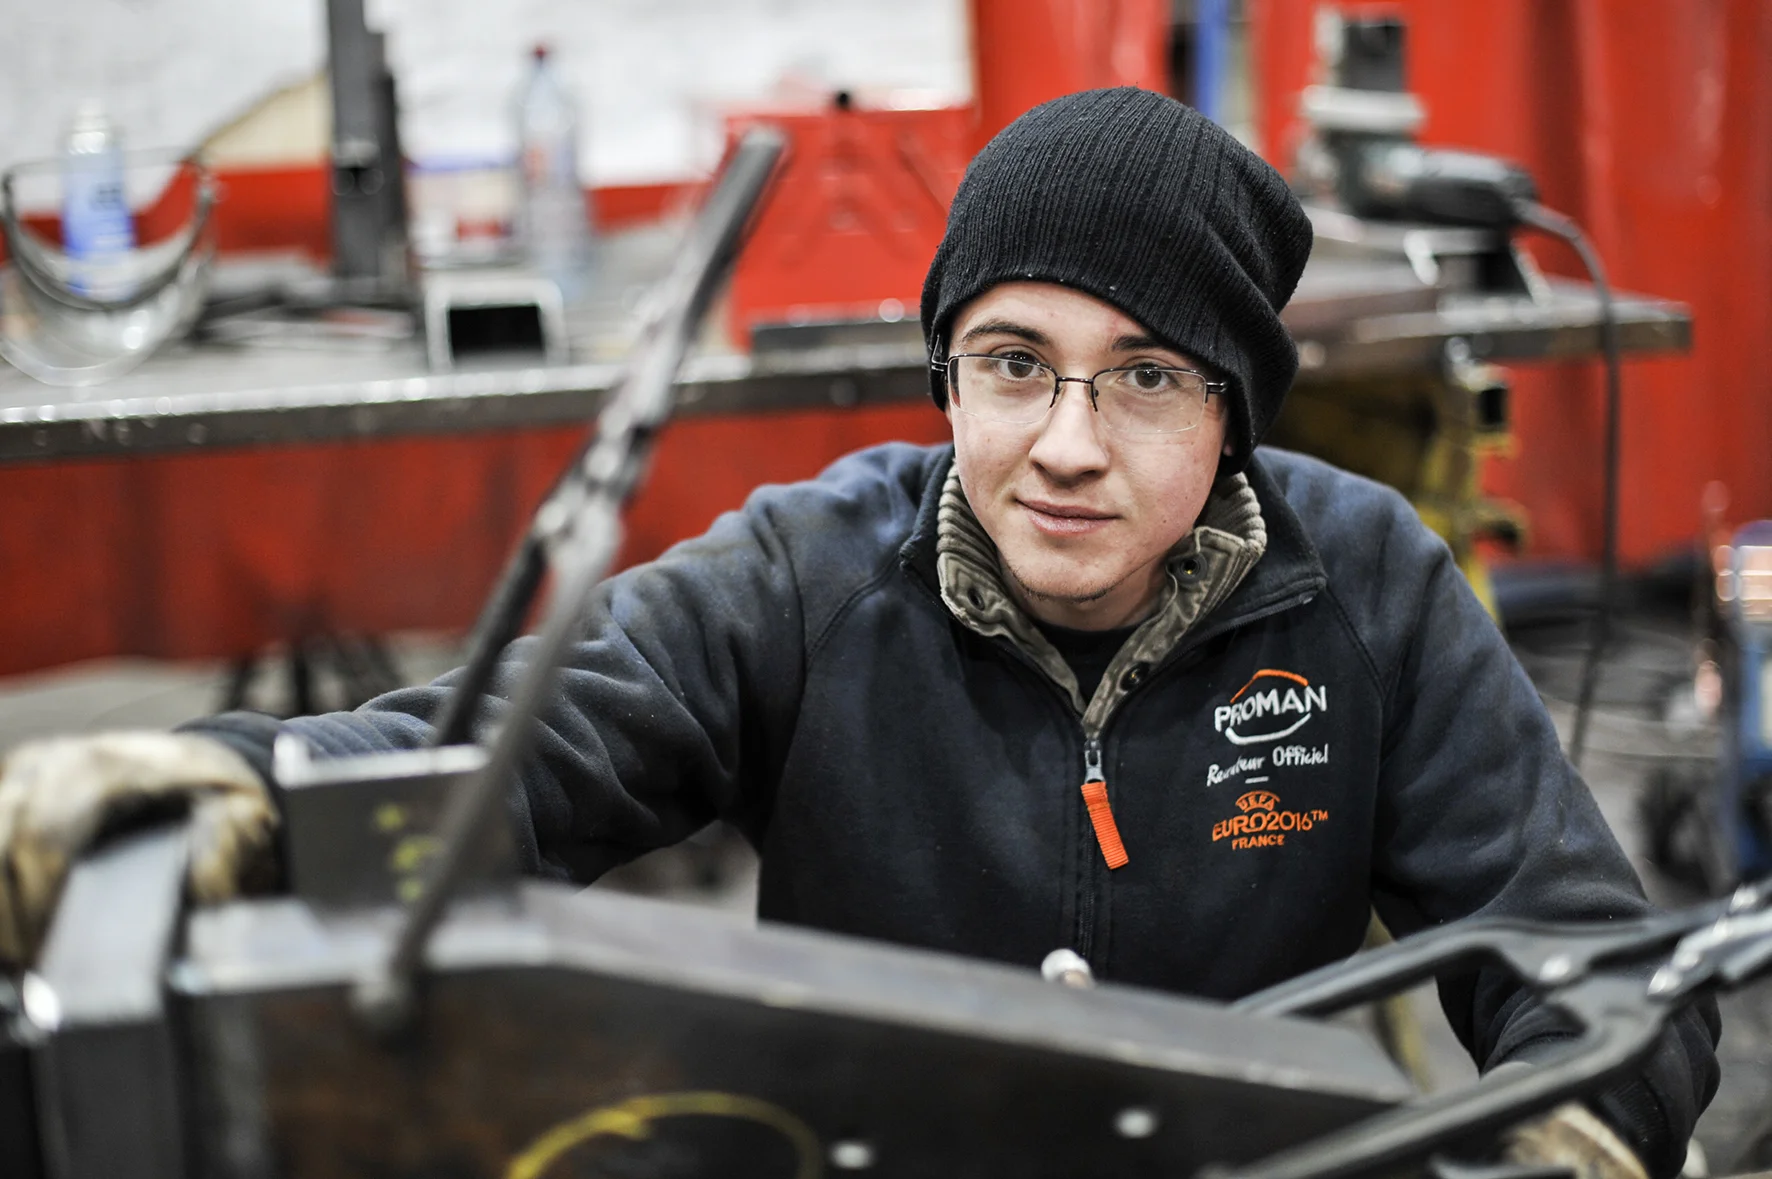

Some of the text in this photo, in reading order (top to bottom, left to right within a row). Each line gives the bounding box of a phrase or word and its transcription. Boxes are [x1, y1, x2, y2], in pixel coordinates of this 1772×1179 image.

[1214, 685, 1327, 732] PROMAN
[1272, 743, 1329, 767] Officiel
[1237, 792, 1277, 813] UEFA
[1231, 834, 1285, 850] FRANCE
